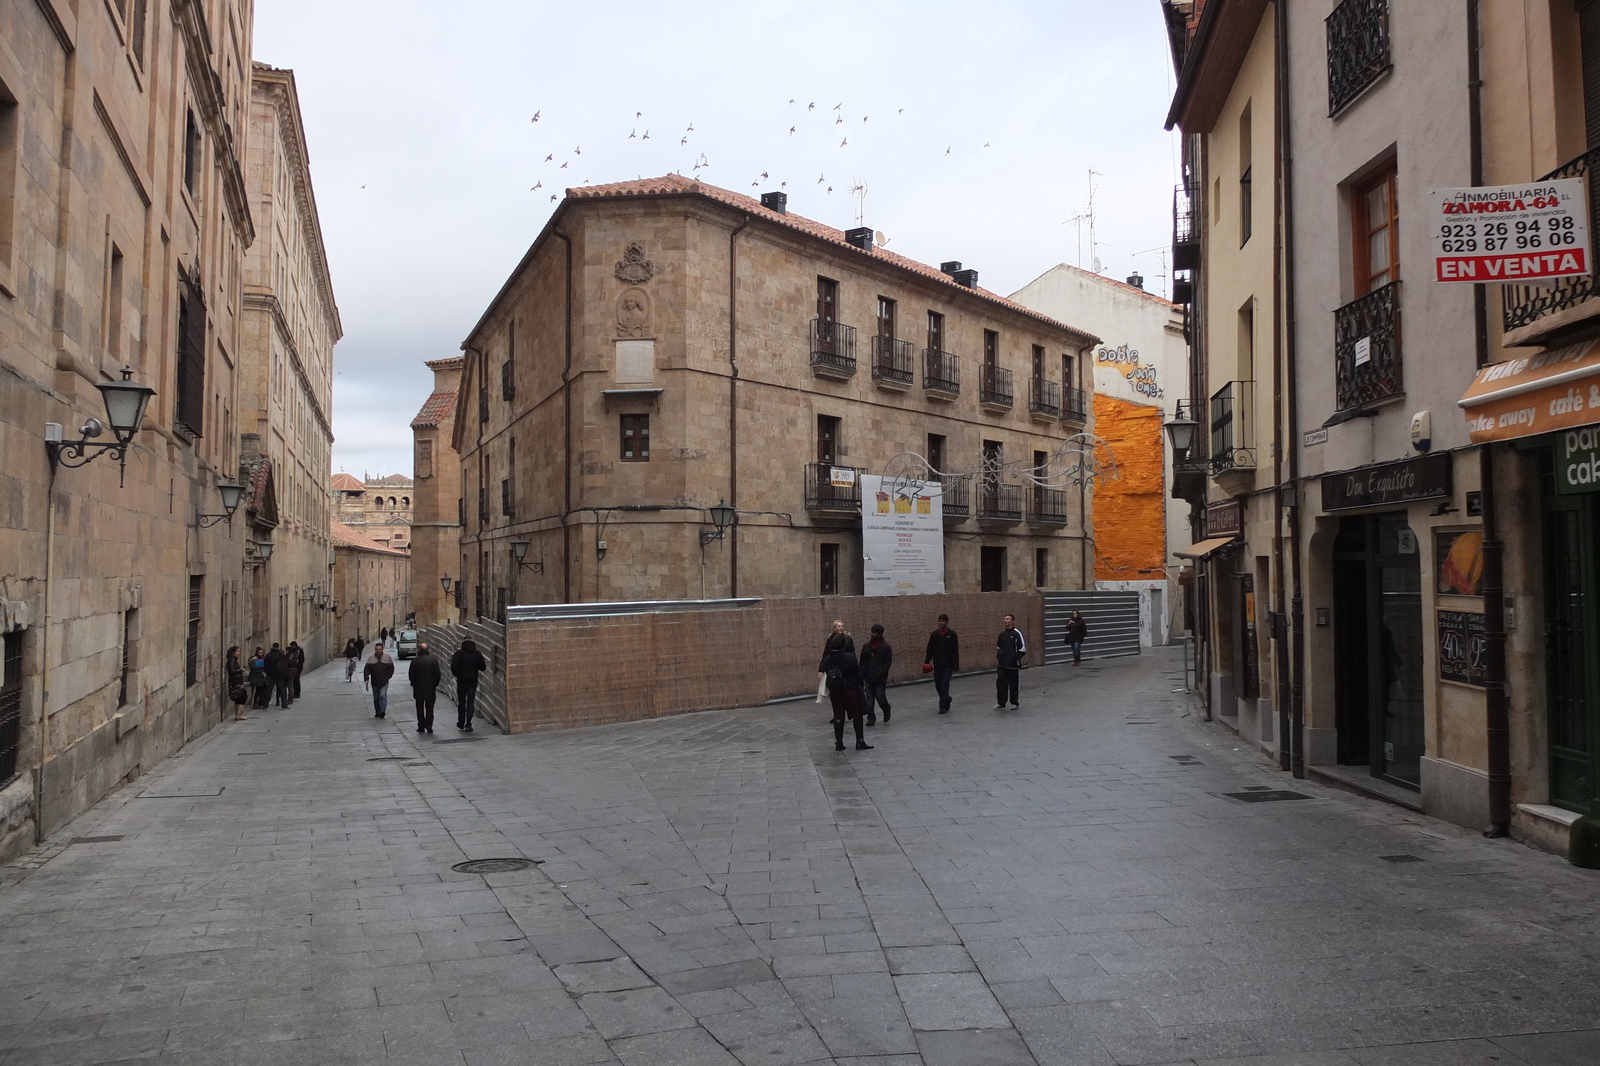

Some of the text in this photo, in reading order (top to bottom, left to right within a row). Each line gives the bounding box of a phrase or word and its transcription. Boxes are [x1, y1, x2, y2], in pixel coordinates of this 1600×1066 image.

[1443, 195, 1560, 214] ZAMORA-64
[1463, 187, 1557, 202] INMOBILIARIA
[1531, 209, 1567, 217] viviendas
[1441, 216, 1575, 238] 923 26 94 98
[1441, 231, 1576, 252] 629 87 96 06
[1441, 253, 1580, 278] EN VENTA
[1498, 407, 1537, 428] away
[1549, 387, 1584, 416] café
[1346, 476, 1364, 497] Don
[1368, 466, 1415, 502] Exquisito
